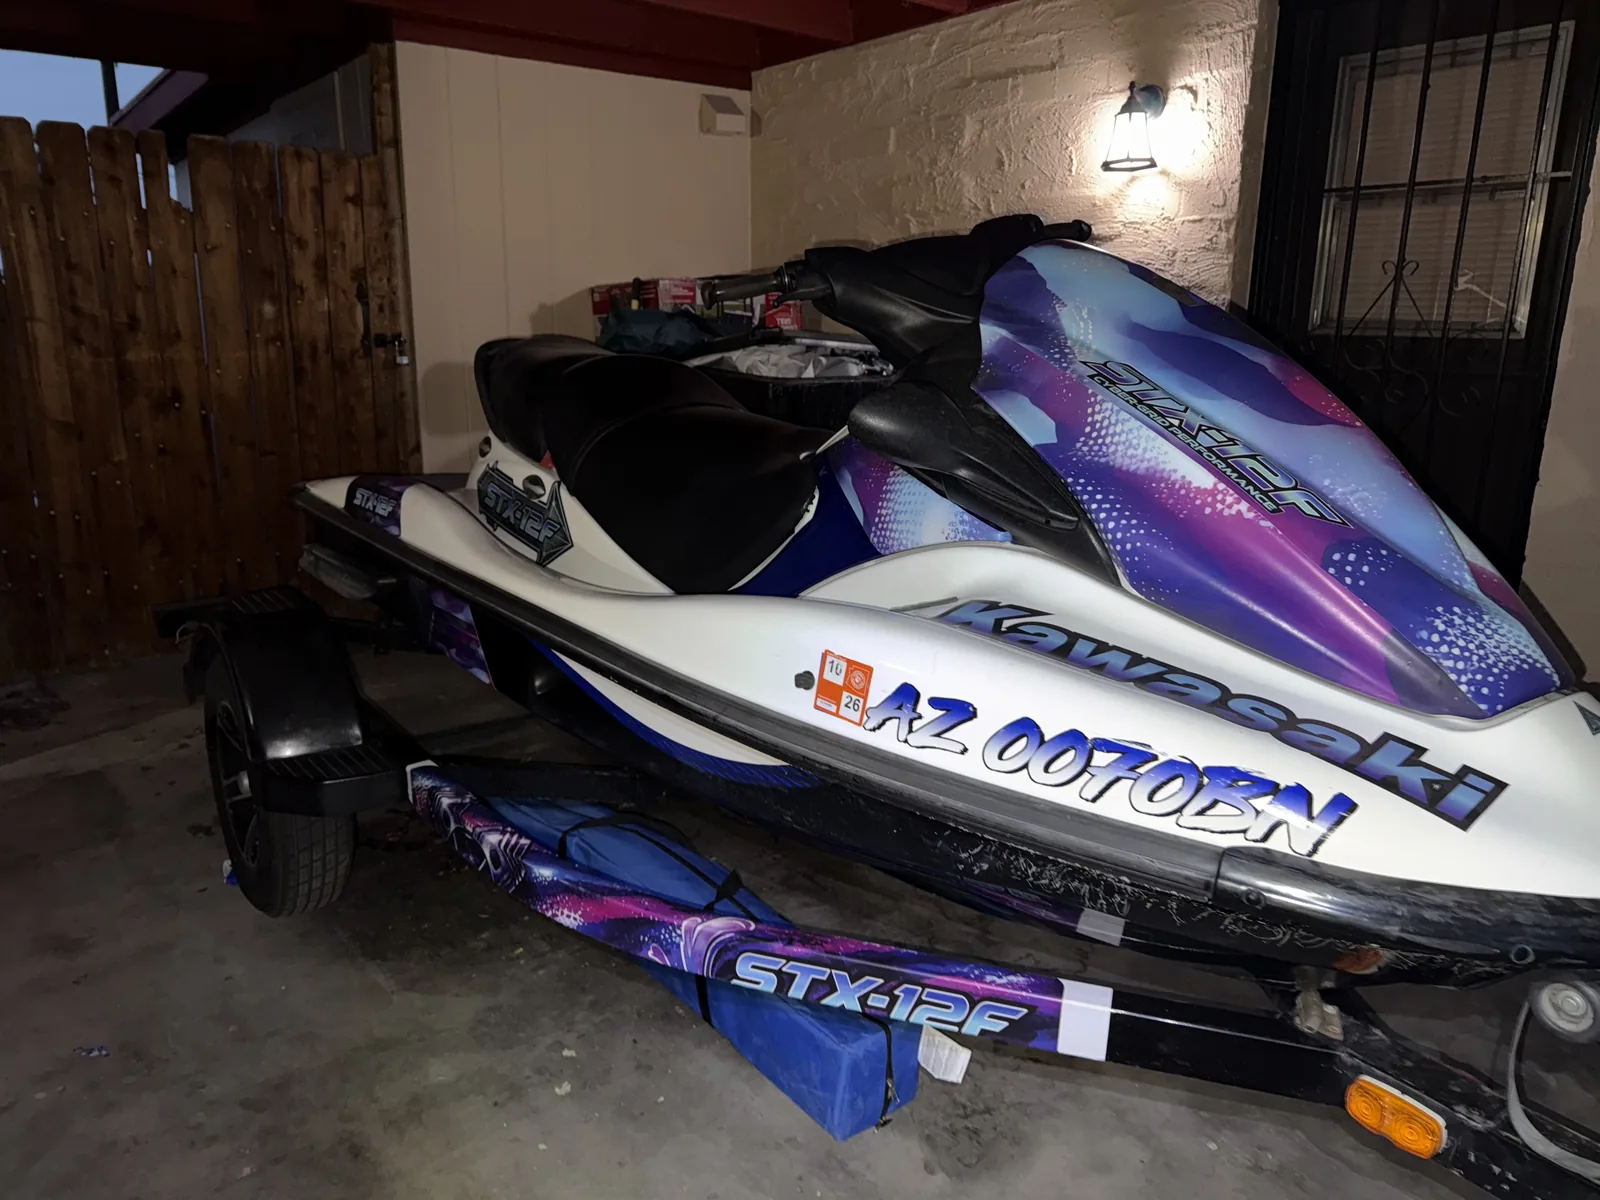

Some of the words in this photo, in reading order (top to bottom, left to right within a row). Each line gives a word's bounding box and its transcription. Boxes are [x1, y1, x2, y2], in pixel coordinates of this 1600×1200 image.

[1093, 376, 1171, 427] CYBER-GRID
[1168, 426, 1278, 513] PERFORMANCE
[483, 482, 561, 542] STX-12F
[828, 659, 842, 676] 10
[843, 694, 861, 712] 26
[938, 600, 1510, 832] Kawasaki
[863, 682, 977, 756] AZ
[982, 716, 1359, 858] 0070BN
[731, 952, 1028, 1036] STX-12F
